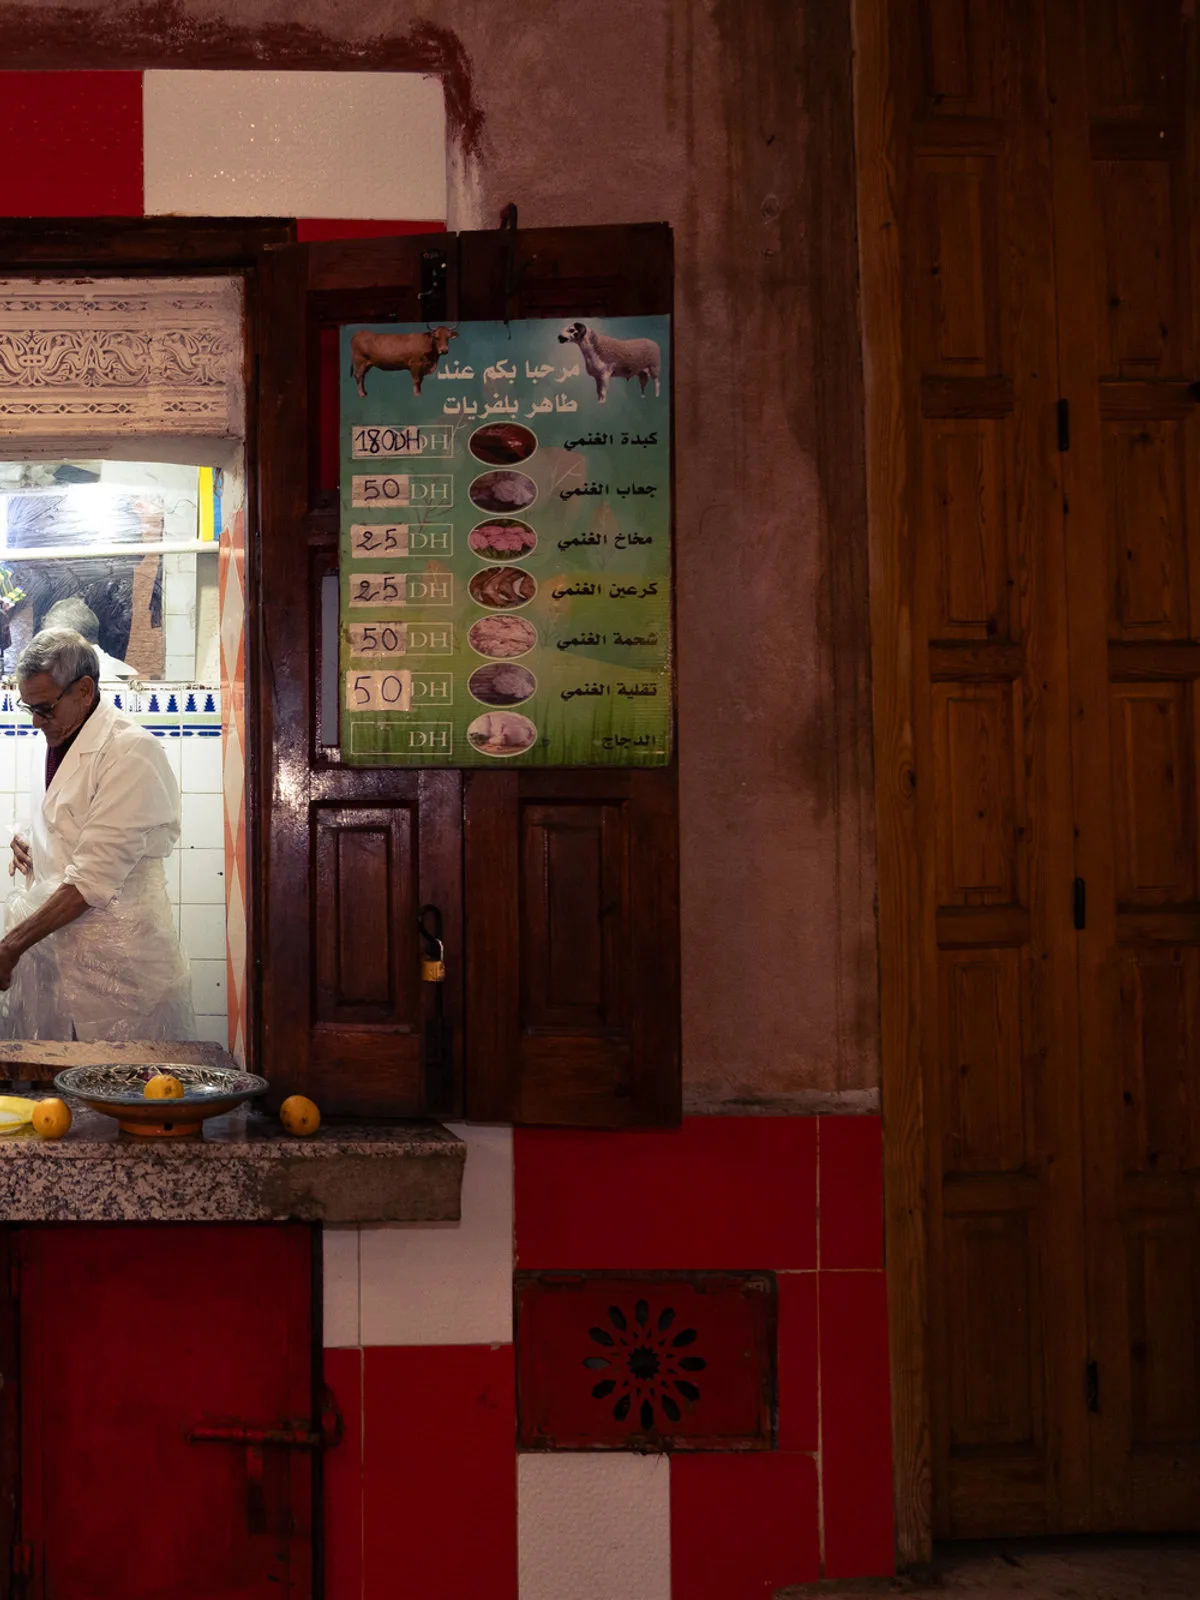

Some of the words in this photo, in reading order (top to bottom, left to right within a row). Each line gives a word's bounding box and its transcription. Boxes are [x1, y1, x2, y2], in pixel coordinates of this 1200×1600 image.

[437, 360, 475, 380] عند
[483, 359, 517, 385] بكم
[525, 359, 580, 385] مرحبا
[524, 392, 579, 419] طاهر
[564, 432, 613, 451] الغنمي
[620, 432, 658, 449] كبدة
[363, 478, 400, 501] 50
[411, 483, 448, 499] DH
[560, 483, 609, 501] الغنمي
[356, 528, 398, 550] 25
[410, 532, 448, 549] DH
[557, 532, 607, 550] الغنمي
[354, 577, 399, 601] 25
[409, 582, 448, 598] DH
[552, 582, 601, 600] الغنمي
[609, 582, 658, 598] كرعين
[361, 628, 398, 652] 50
[410, 631, 448, 648] DH
[557, 632, 606, 649] الغنمي
[354, 675, 402, 704] 50
[561, 682, 610, 699] الغنمي
[408, 730, 448, 747] DH
[601, 734, 656, 750] الدجاج
